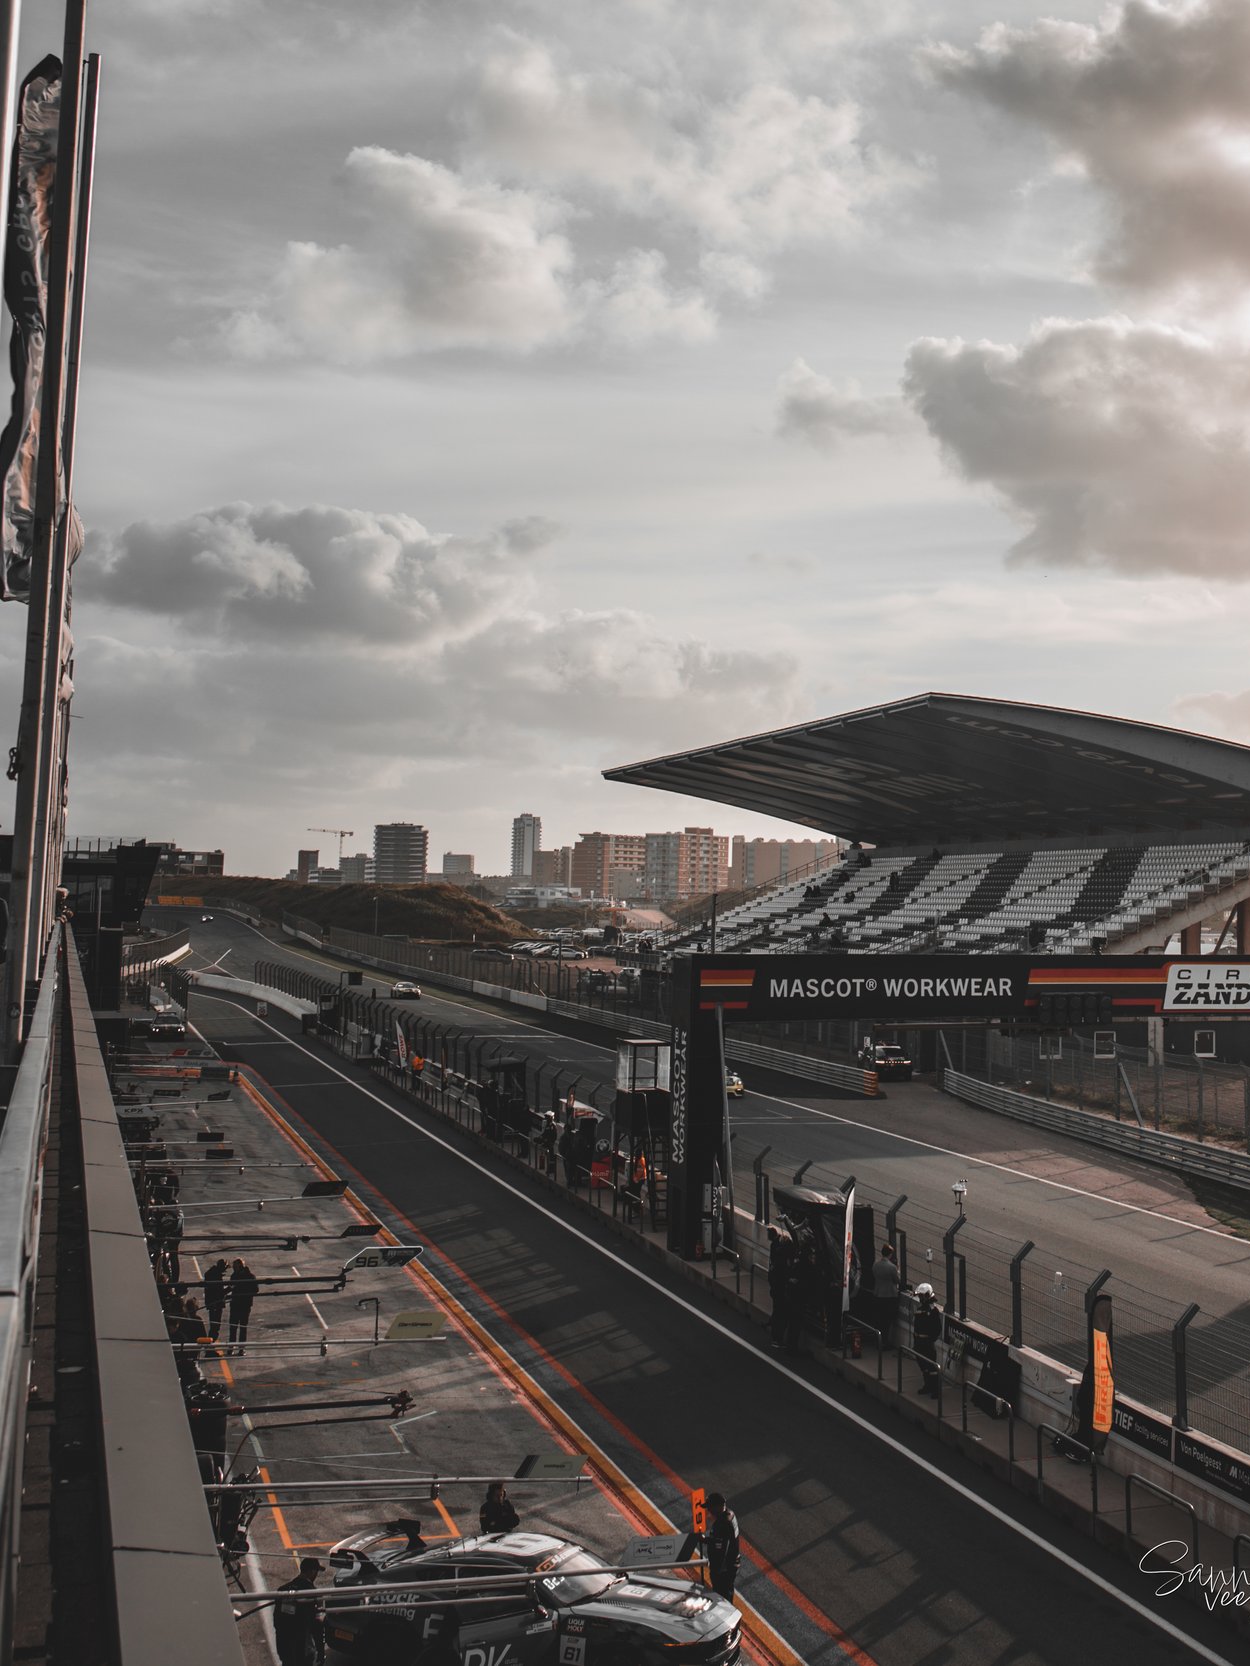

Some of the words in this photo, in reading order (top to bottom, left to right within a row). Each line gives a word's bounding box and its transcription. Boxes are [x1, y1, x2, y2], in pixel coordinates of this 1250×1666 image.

[883, 978, 1013, 997] WORKWEAR
[679, 1031, 687, 1165] WORKWEAR
[355, 1256, 379, 1268] 96
[1181, 1440, 1192, 1456] Van
[1192, 1446, 1222, 1471] Poelgeest
[563, 1646, 582, 1662] 61
